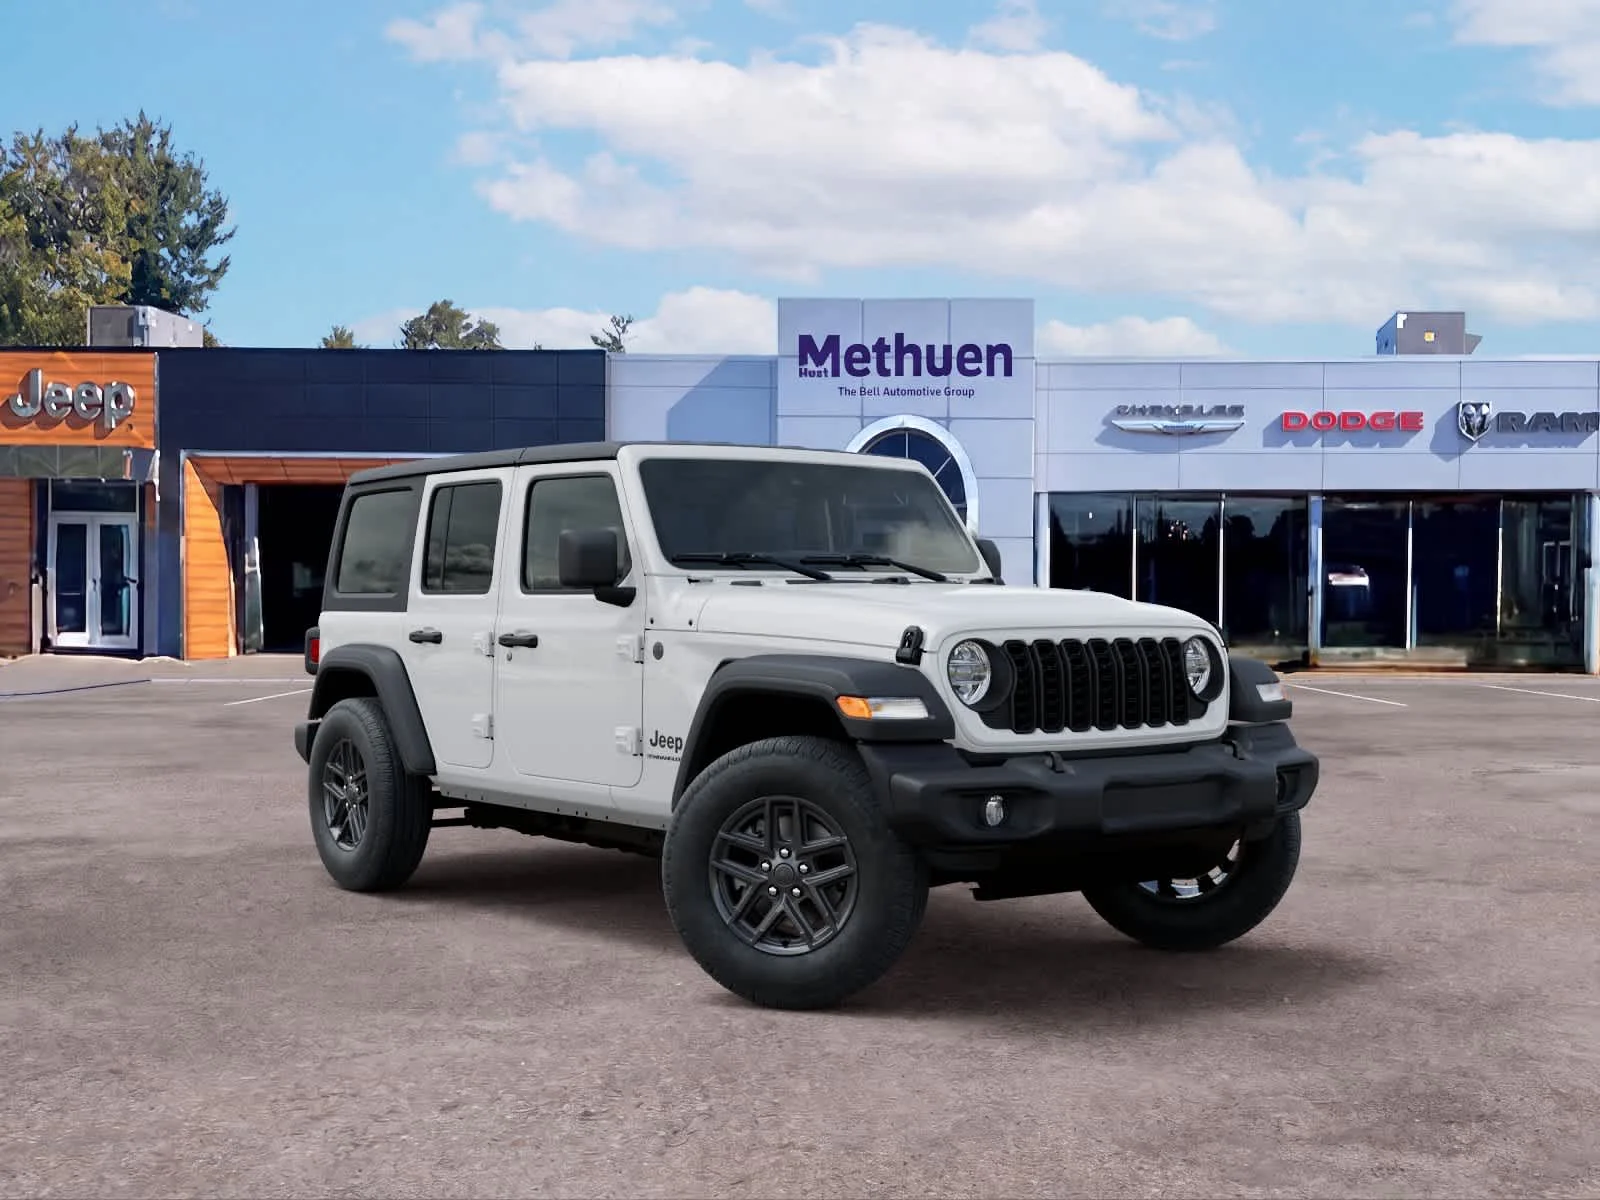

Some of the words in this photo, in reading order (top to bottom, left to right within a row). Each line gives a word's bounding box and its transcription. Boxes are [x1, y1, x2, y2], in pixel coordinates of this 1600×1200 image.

[798, 332, 1013, 378] Methuen
[9, 368, 136, 430] Jeep
[838, 386, 857, 397] The
[859, 386, 880, 397] Bell
[883, 386, 941, 397] Automotive
[944, 386, 975, 399] Group
[1281, 411, 1424, 433] DODGE
[1497, 411, 1600, 433] RAM
[649, 730, 683, 753] Jeep
